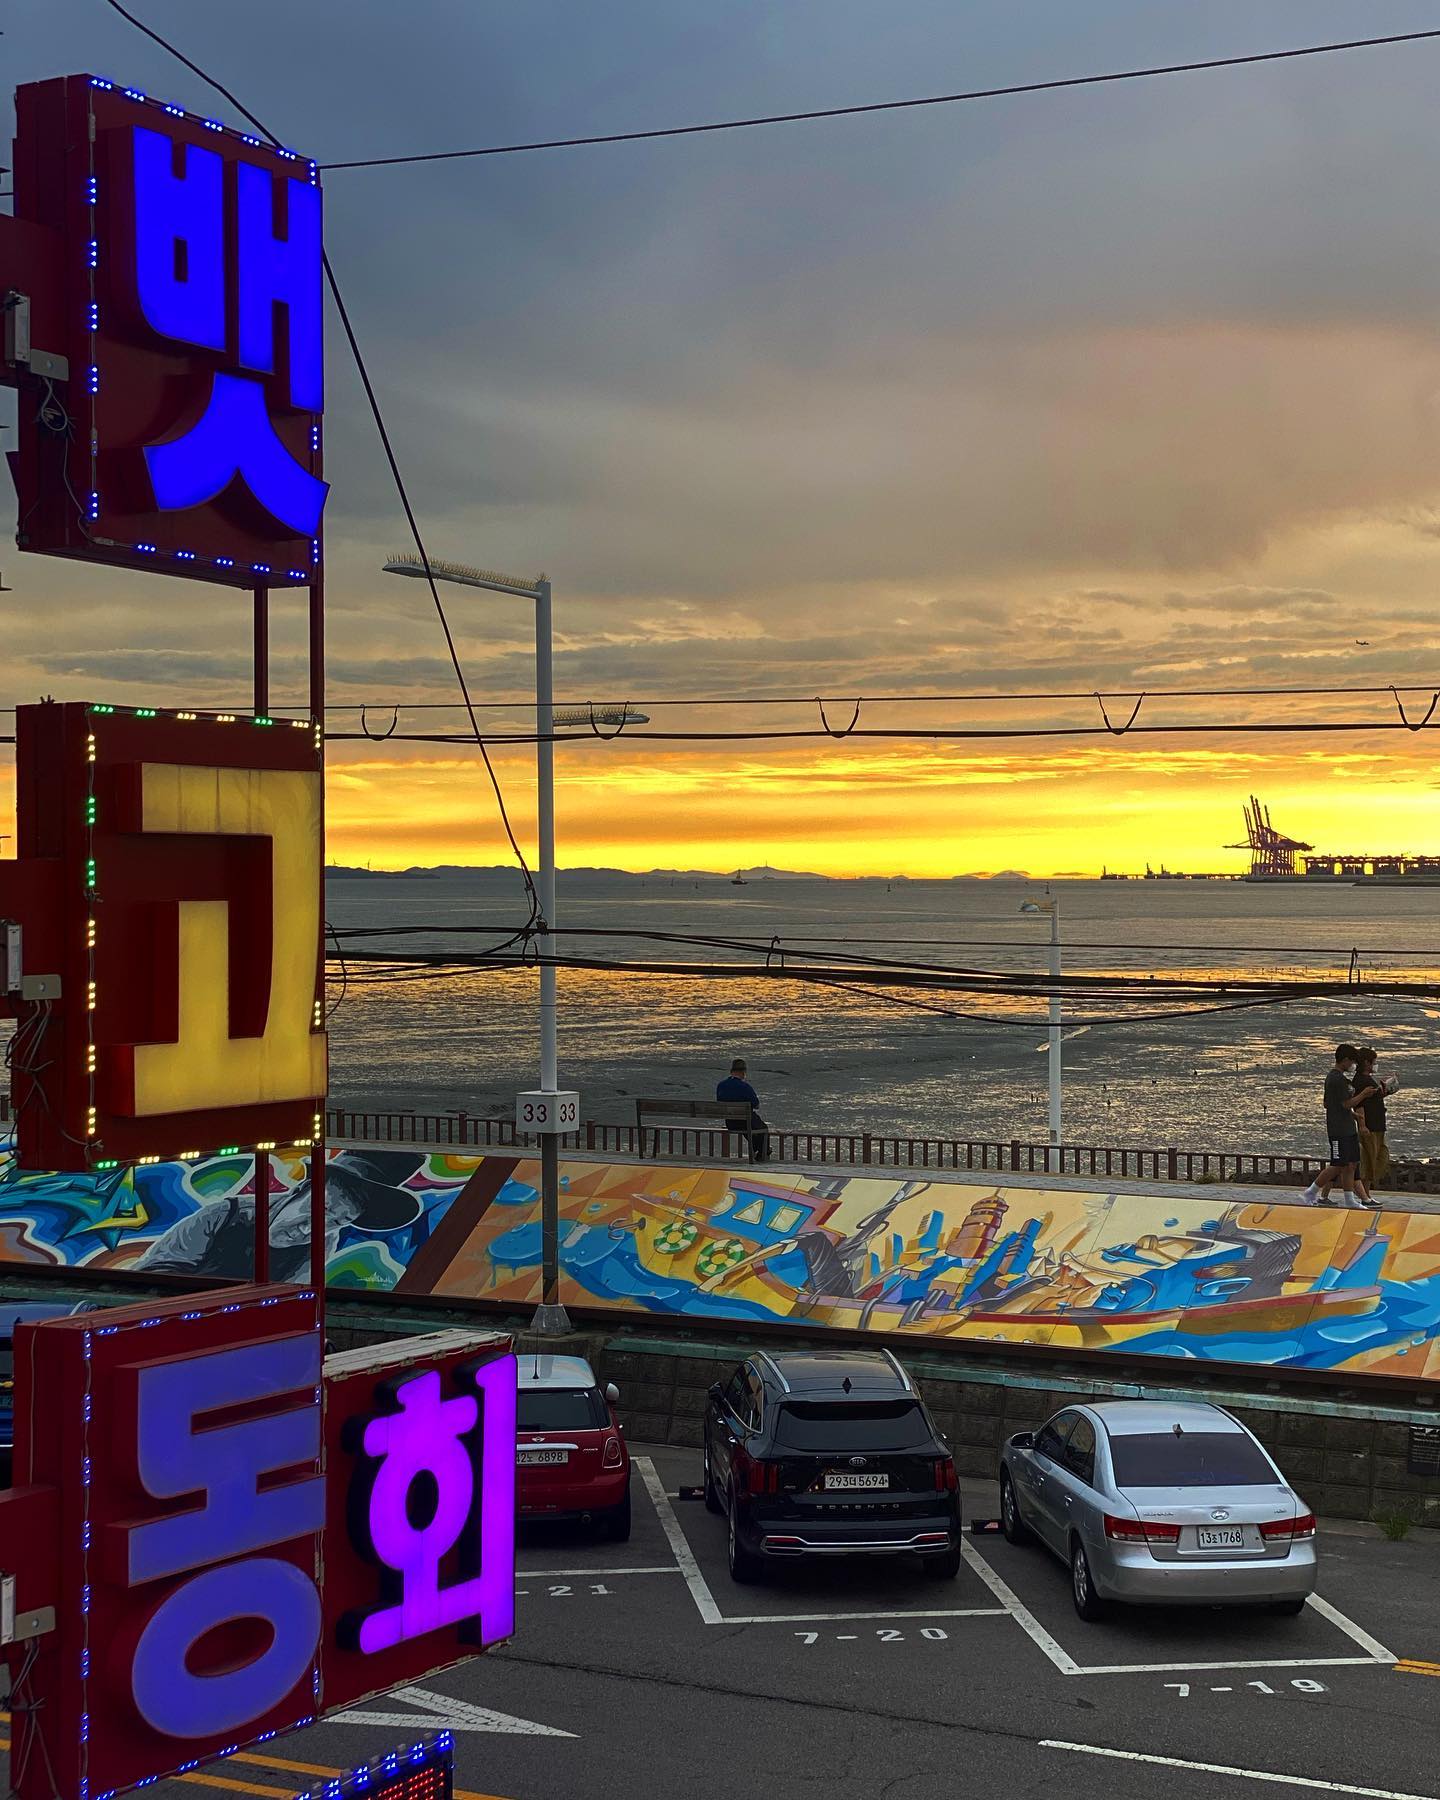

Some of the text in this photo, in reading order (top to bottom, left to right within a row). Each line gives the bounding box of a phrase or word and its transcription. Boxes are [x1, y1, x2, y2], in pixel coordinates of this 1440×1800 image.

[523, 1103, 548, 1123] 33
[560, 1102, 576, 1123] 33
[538, 1451, 564, 1463] 6898
[858, 1475, 885, 1487] 5694
[358, 1351, 518, 1656] 회
